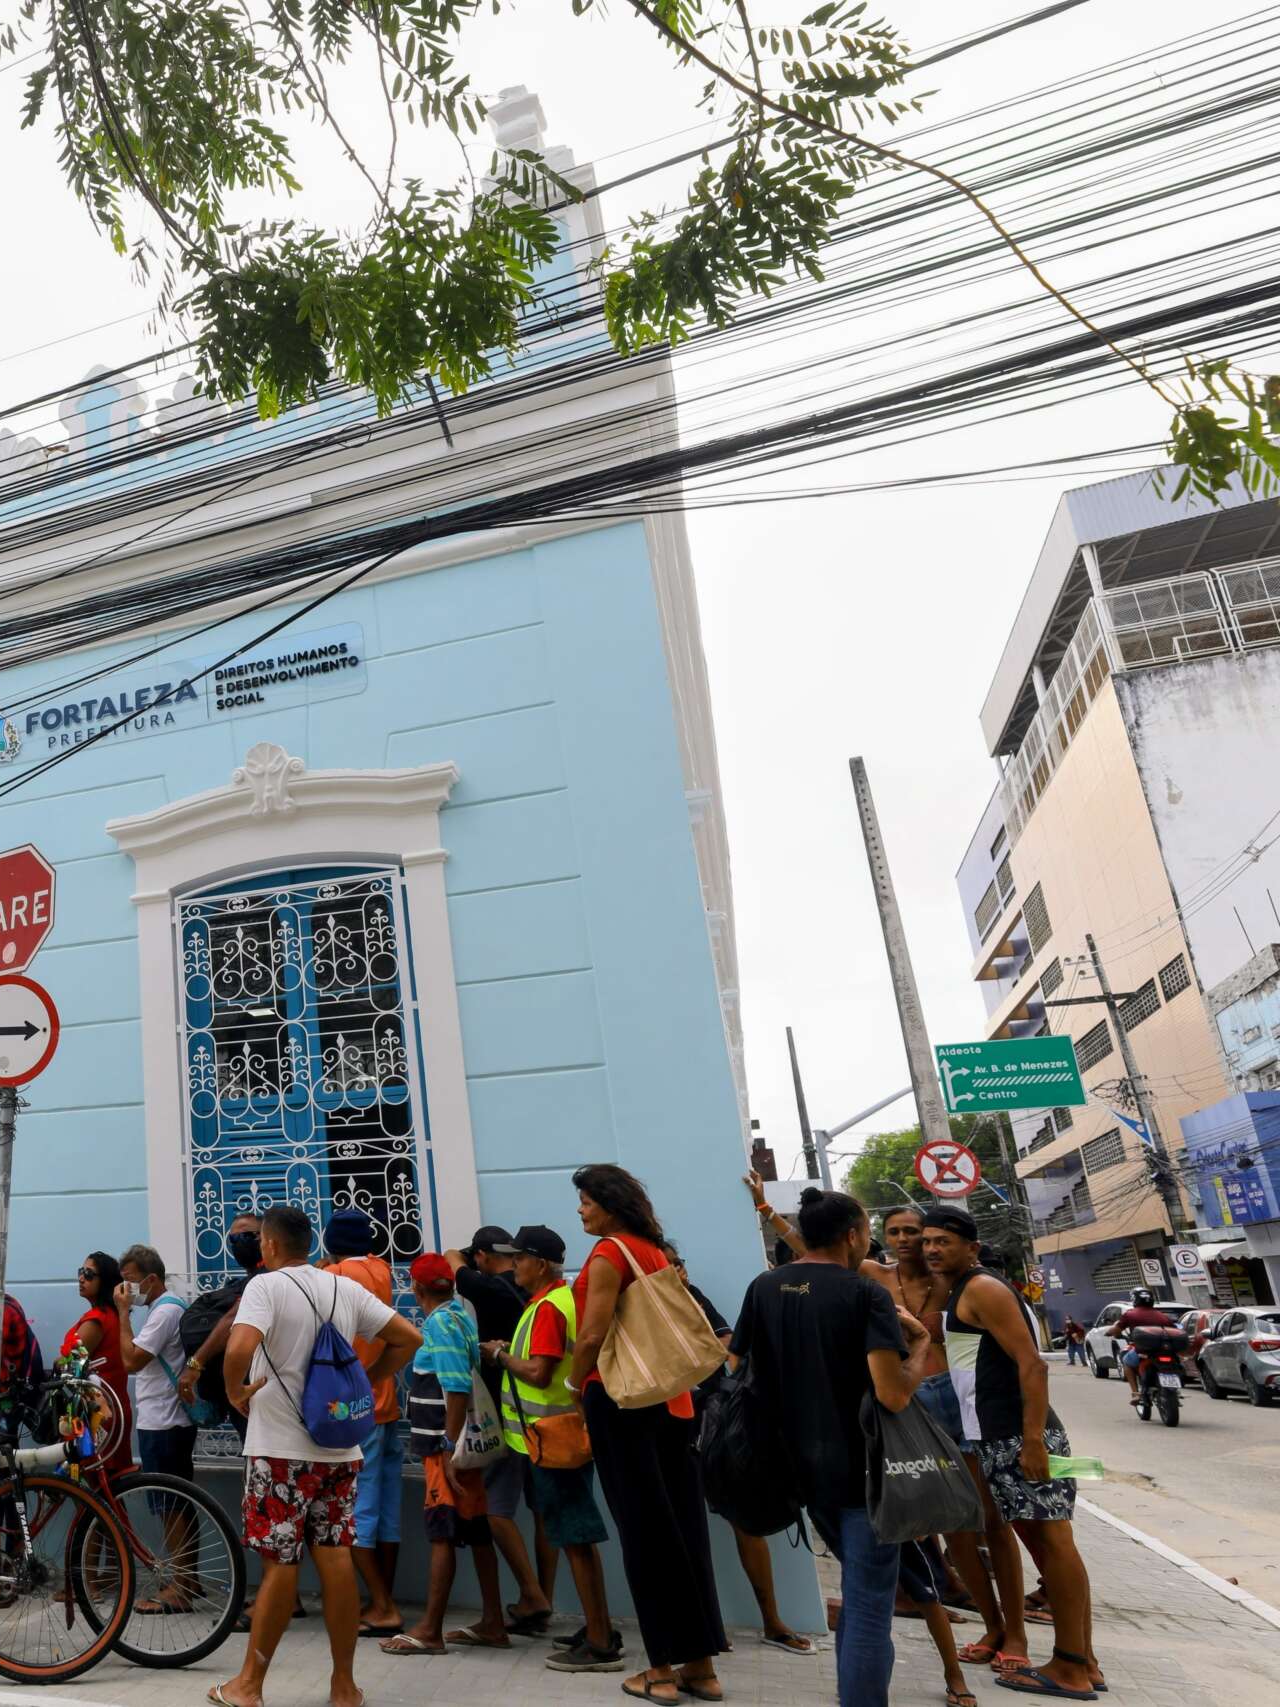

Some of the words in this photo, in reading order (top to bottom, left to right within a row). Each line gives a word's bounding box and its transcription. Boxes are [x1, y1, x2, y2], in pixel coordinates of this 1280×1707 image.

[215, 659, 274, 681] DIREITOS
[277, 643, 348, 667] HUMANOS
[216, 685, 224, 695] E
[227, 656, 359, 693] DESENVOLVIMENTO
[25, 677, 198, 735] FORTALEZA
[216, 692, 264, 710] SOCIAL
[938, 1046, 982, 1056] Aldeota
[974, 1065, 989, 1074] Av.
[991, 1064, 1001, 1072] B.
[1004, 1063, 1018, 1072] de
[1021, 1060, 1069, 1071] Menezes
[978, 1090, 1018, 1100] Centro
